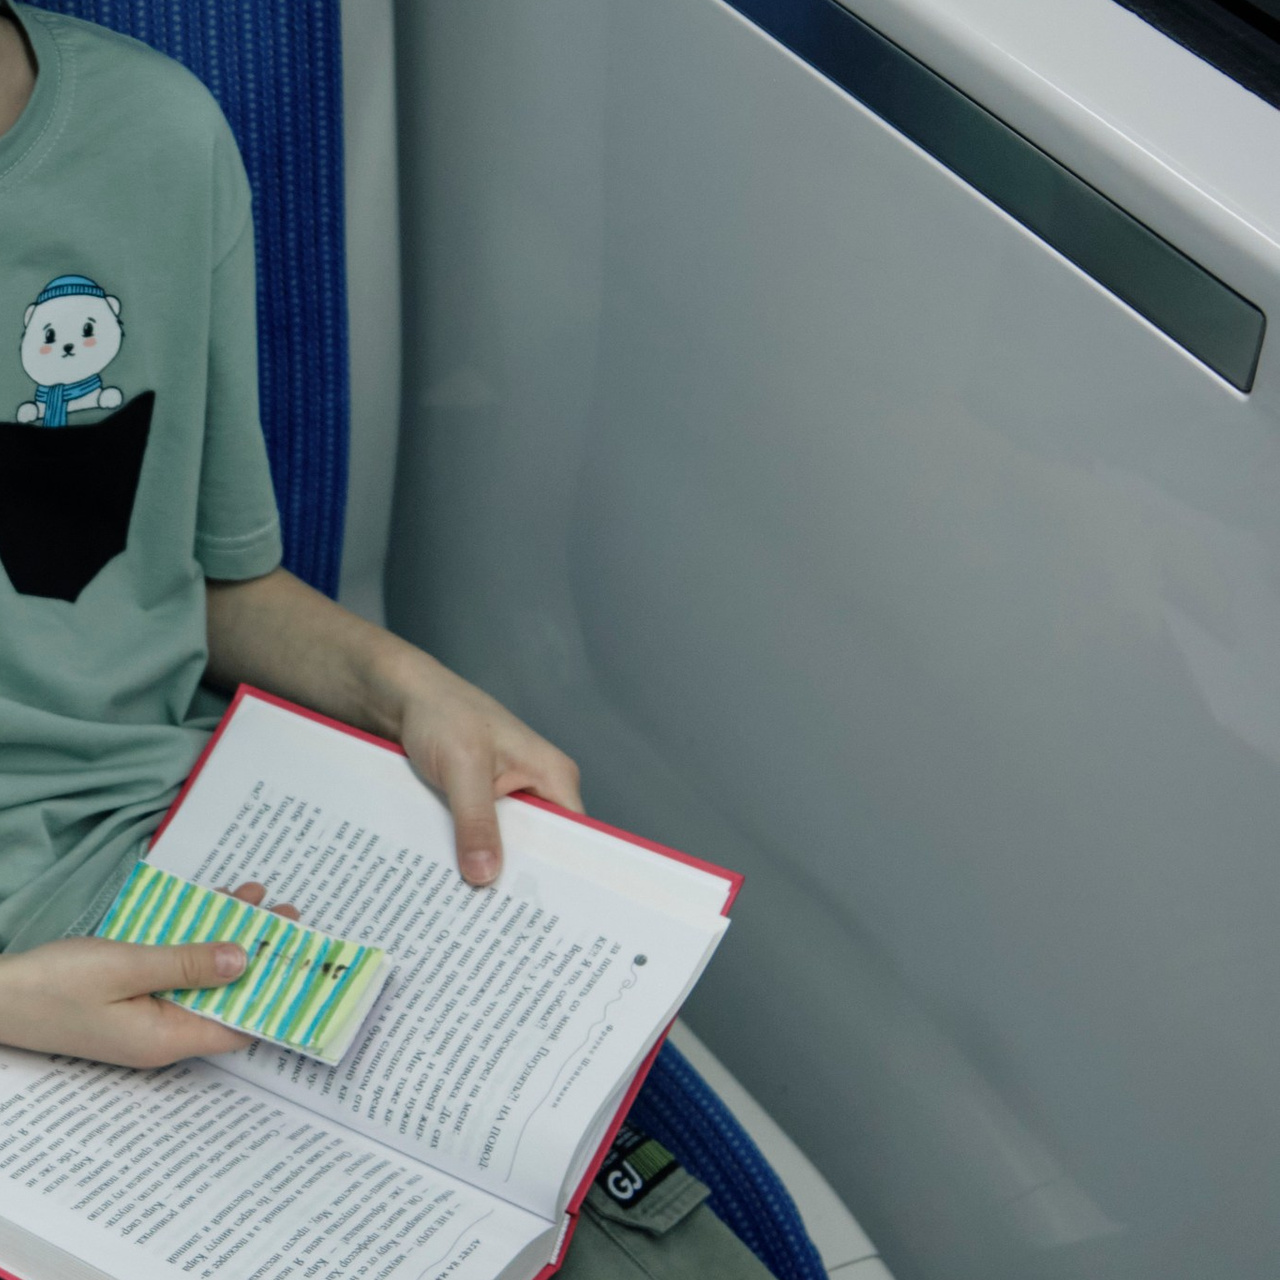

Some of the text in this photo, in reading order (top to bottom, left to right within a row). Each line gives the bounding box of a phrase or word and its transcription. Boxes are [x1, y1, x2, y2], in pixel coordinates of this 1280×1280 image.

[217, 780, 265, 847] ем? Это была
[289, 801, 308, 822] тебе
[209, 802, 272, 884] Разве это можно
[237, 795, 295, 870] Только потерпи
[294, 817, 315, 844] вижу
[275, 844, 319, 895] Ты хочешь
[308, 845, 337, 876] Потом
[316, 827, 365, 892] тила меня на
[329, 833, 380, 900] вился своей
[372, 848, 409, 894] чи! Какое
[415, 861, 439, 888] точку
[332, 855, 387, 921] Расстроенный
[358, 854, 424, 940] не растолстел! Об
[402, 867, 453, 932] которые Анна
[442, 894, 454, 907] от
[499, 901, 529, 937] почаще
[542, 915, 559, 934] пор
[433, 929, 450, 944] Он
[474, 928, 490, 944] что
[528, 934, 546, 954] мне
[588, 935, 607, 957] КЕ?!
[609, 941, 621, 955] ла
[456, 946, 476, 967] наш
[466, 937, 502, 982] выходить
[552, 943, 583, 977] Вернер
[423, 969, 459, 1012] приятель
[455, 983, 469, 996] на
[578, 957, 612, 997] погулять
[405, 989, 425, 1010] твоя
[482, 1001, 498, 1017] что
[492, 984, 533, 1030] Уинстона
[515, 979, 554, 1027] задумчиво
[535, 989, 567, 1030] собака?!
[568, 999, 580, 1012] со
[386, 1011, 409, 1038] мама
[455, 1011, 469, 1025] ты
[470, 1018, 484, 1032] он
[344, 1024, 382, 1082] буквально
[382, 1025, 419, 1081] последнее
[442, 1032, 474, 1076] доволен
[478, 1032, 495, 1051] нет
[478, 1028, 518, 1081] посмотрел
[357, 1039, 390, 1091] слишком
[404, 1048, 427, 1074] Мне
[506, 1046, 550, 1102] Погулять?!
[390, 1076, 408, 1105] тоже
[412, 1072, 429, 1095] ему
[423, 1077, 445, 1111] своей
[467, 1083, 482, 1098] на
[351, 1093, 363, 1113] его
[366, 1084, 385, 1120] время
[398, 1096, 417, 1135] нужно
[437, 1104, 452, 1125] До
[495, 1104, 511, 1121] НА
[429, 1128, 441, 1149] сих
[607, 1161, 643, 1200] GJ
[165, 1188, 255, 1264] блестящей длинной
[181, 1195, 273, 1272] Но через минуту Кира
[323, 1203, 362, 1235] отпустила
[394, 1203, 436, 1238] отговорить
[211, 1237, 249, 1269] поскорее
[281, 1226, 311, 1252] просто
[338, 1232, 380, 1268] профессор
[375, 1238, 401, 1257] Киру
[302, 1257, 330, 1279] Кира
[356, 1265, 369, 1276] ее
[366, 1256, 379, 1267] от
